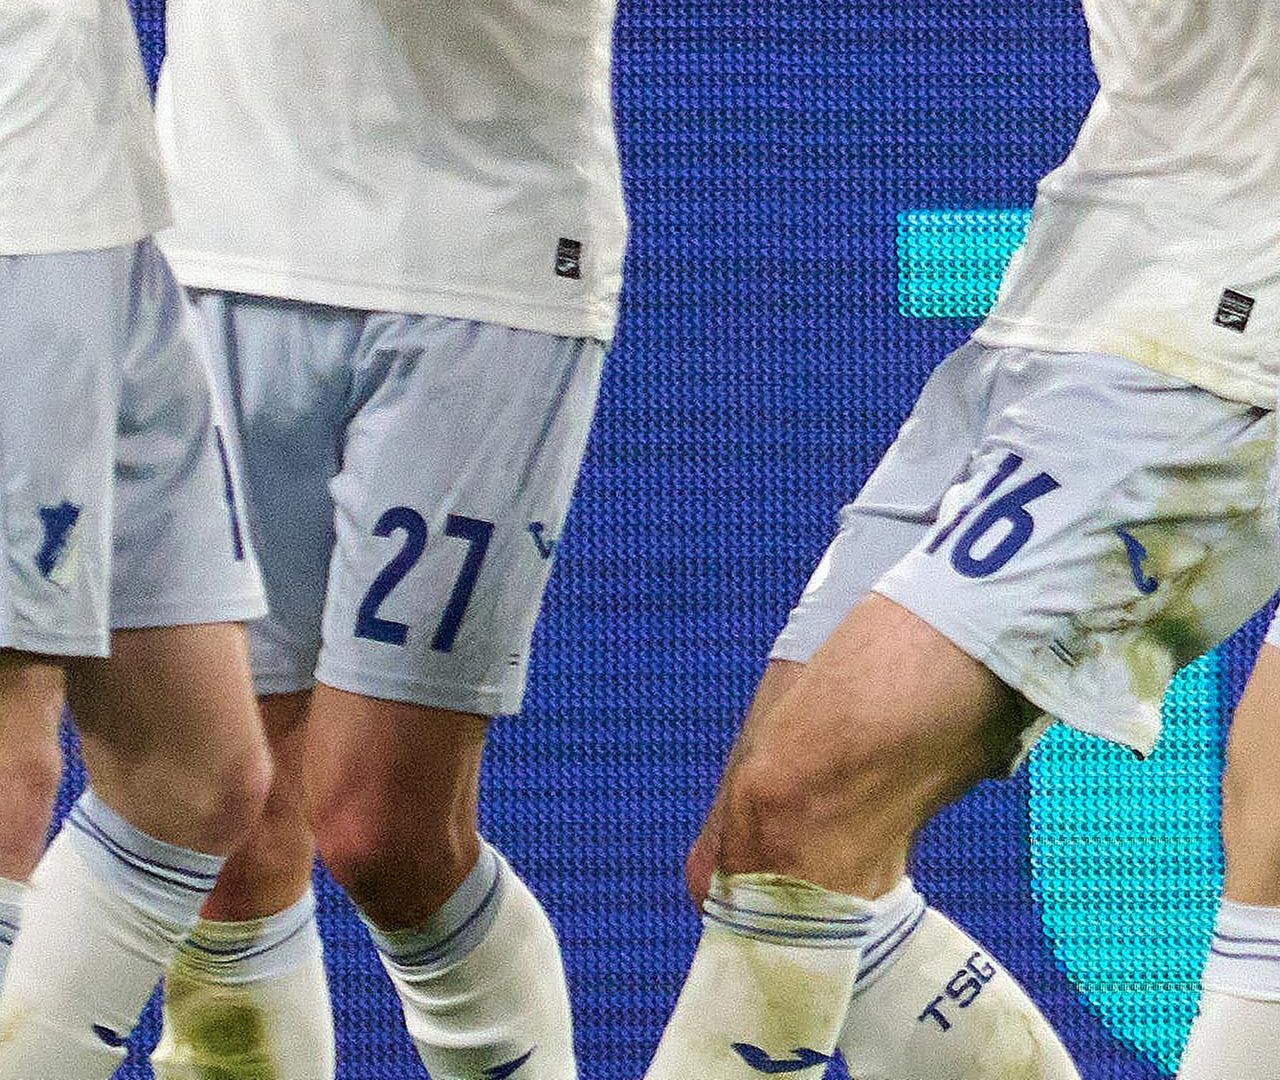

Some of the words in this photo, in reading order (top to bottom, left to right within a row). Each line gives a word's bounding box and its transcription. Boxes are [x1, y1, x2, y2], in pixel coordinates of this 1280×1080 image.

[925, 451, 1062, 579] 16
[354, 506, 496, 653] 27
[918, 951, 997, 1033] TSG
